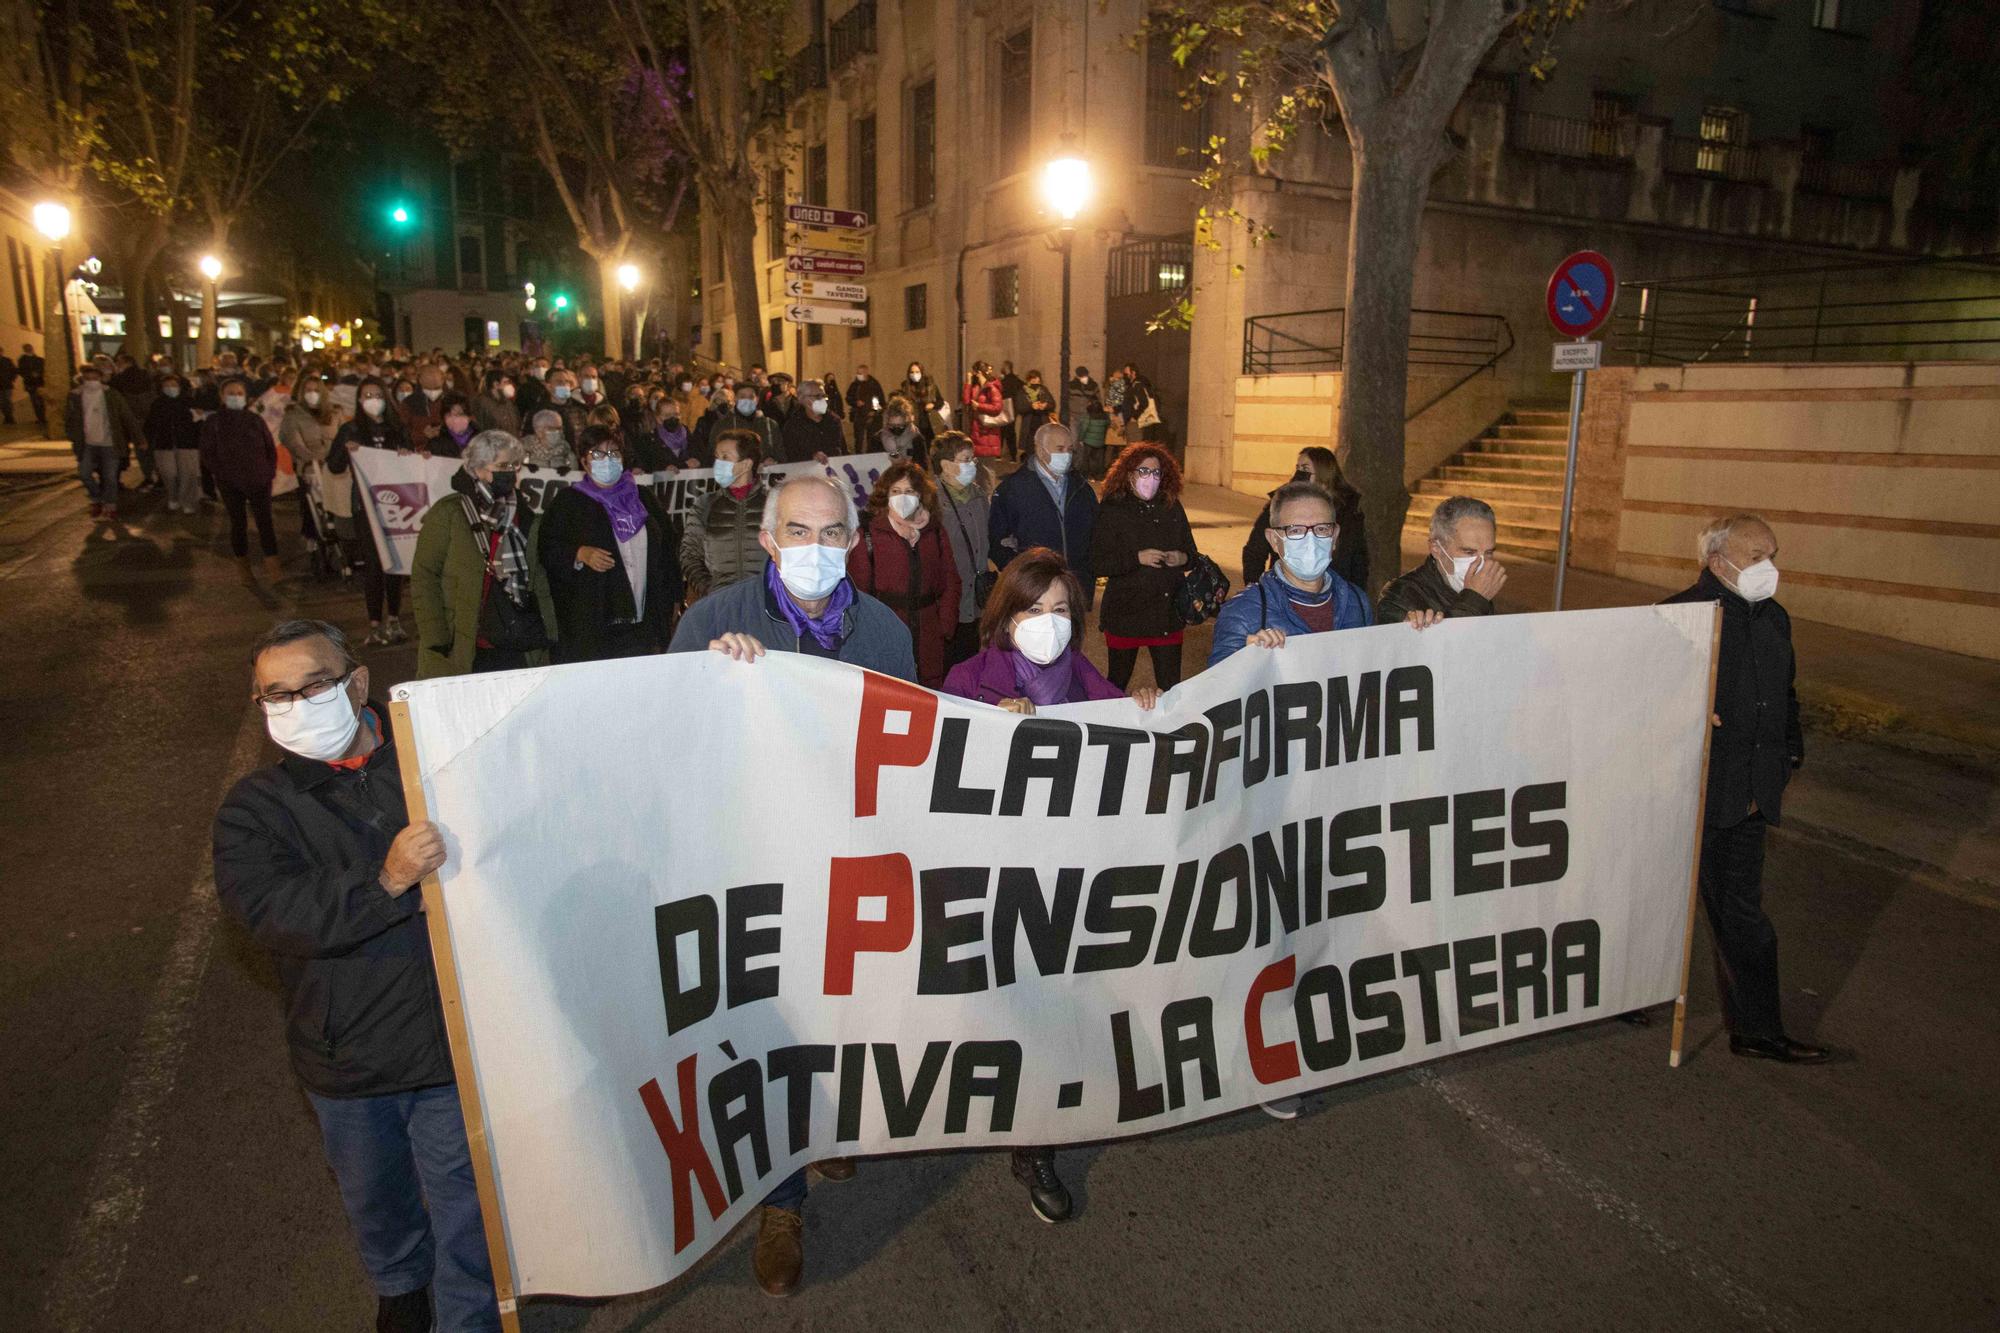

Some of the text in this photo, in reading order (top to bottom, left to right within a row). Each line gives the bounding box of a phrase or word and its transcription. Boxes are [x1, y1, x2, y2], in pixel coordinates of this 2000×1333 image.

[855, 665, 1435, 817] PLATAFORMA
[655, 778, 1570, 1037] DE PENSIONISTES
[638, 1040, 1023, 1255] XÀTIVA
[1110, 996, 1221, 1123] LA
[1244, 919, 1600, 1085] COSTERA
